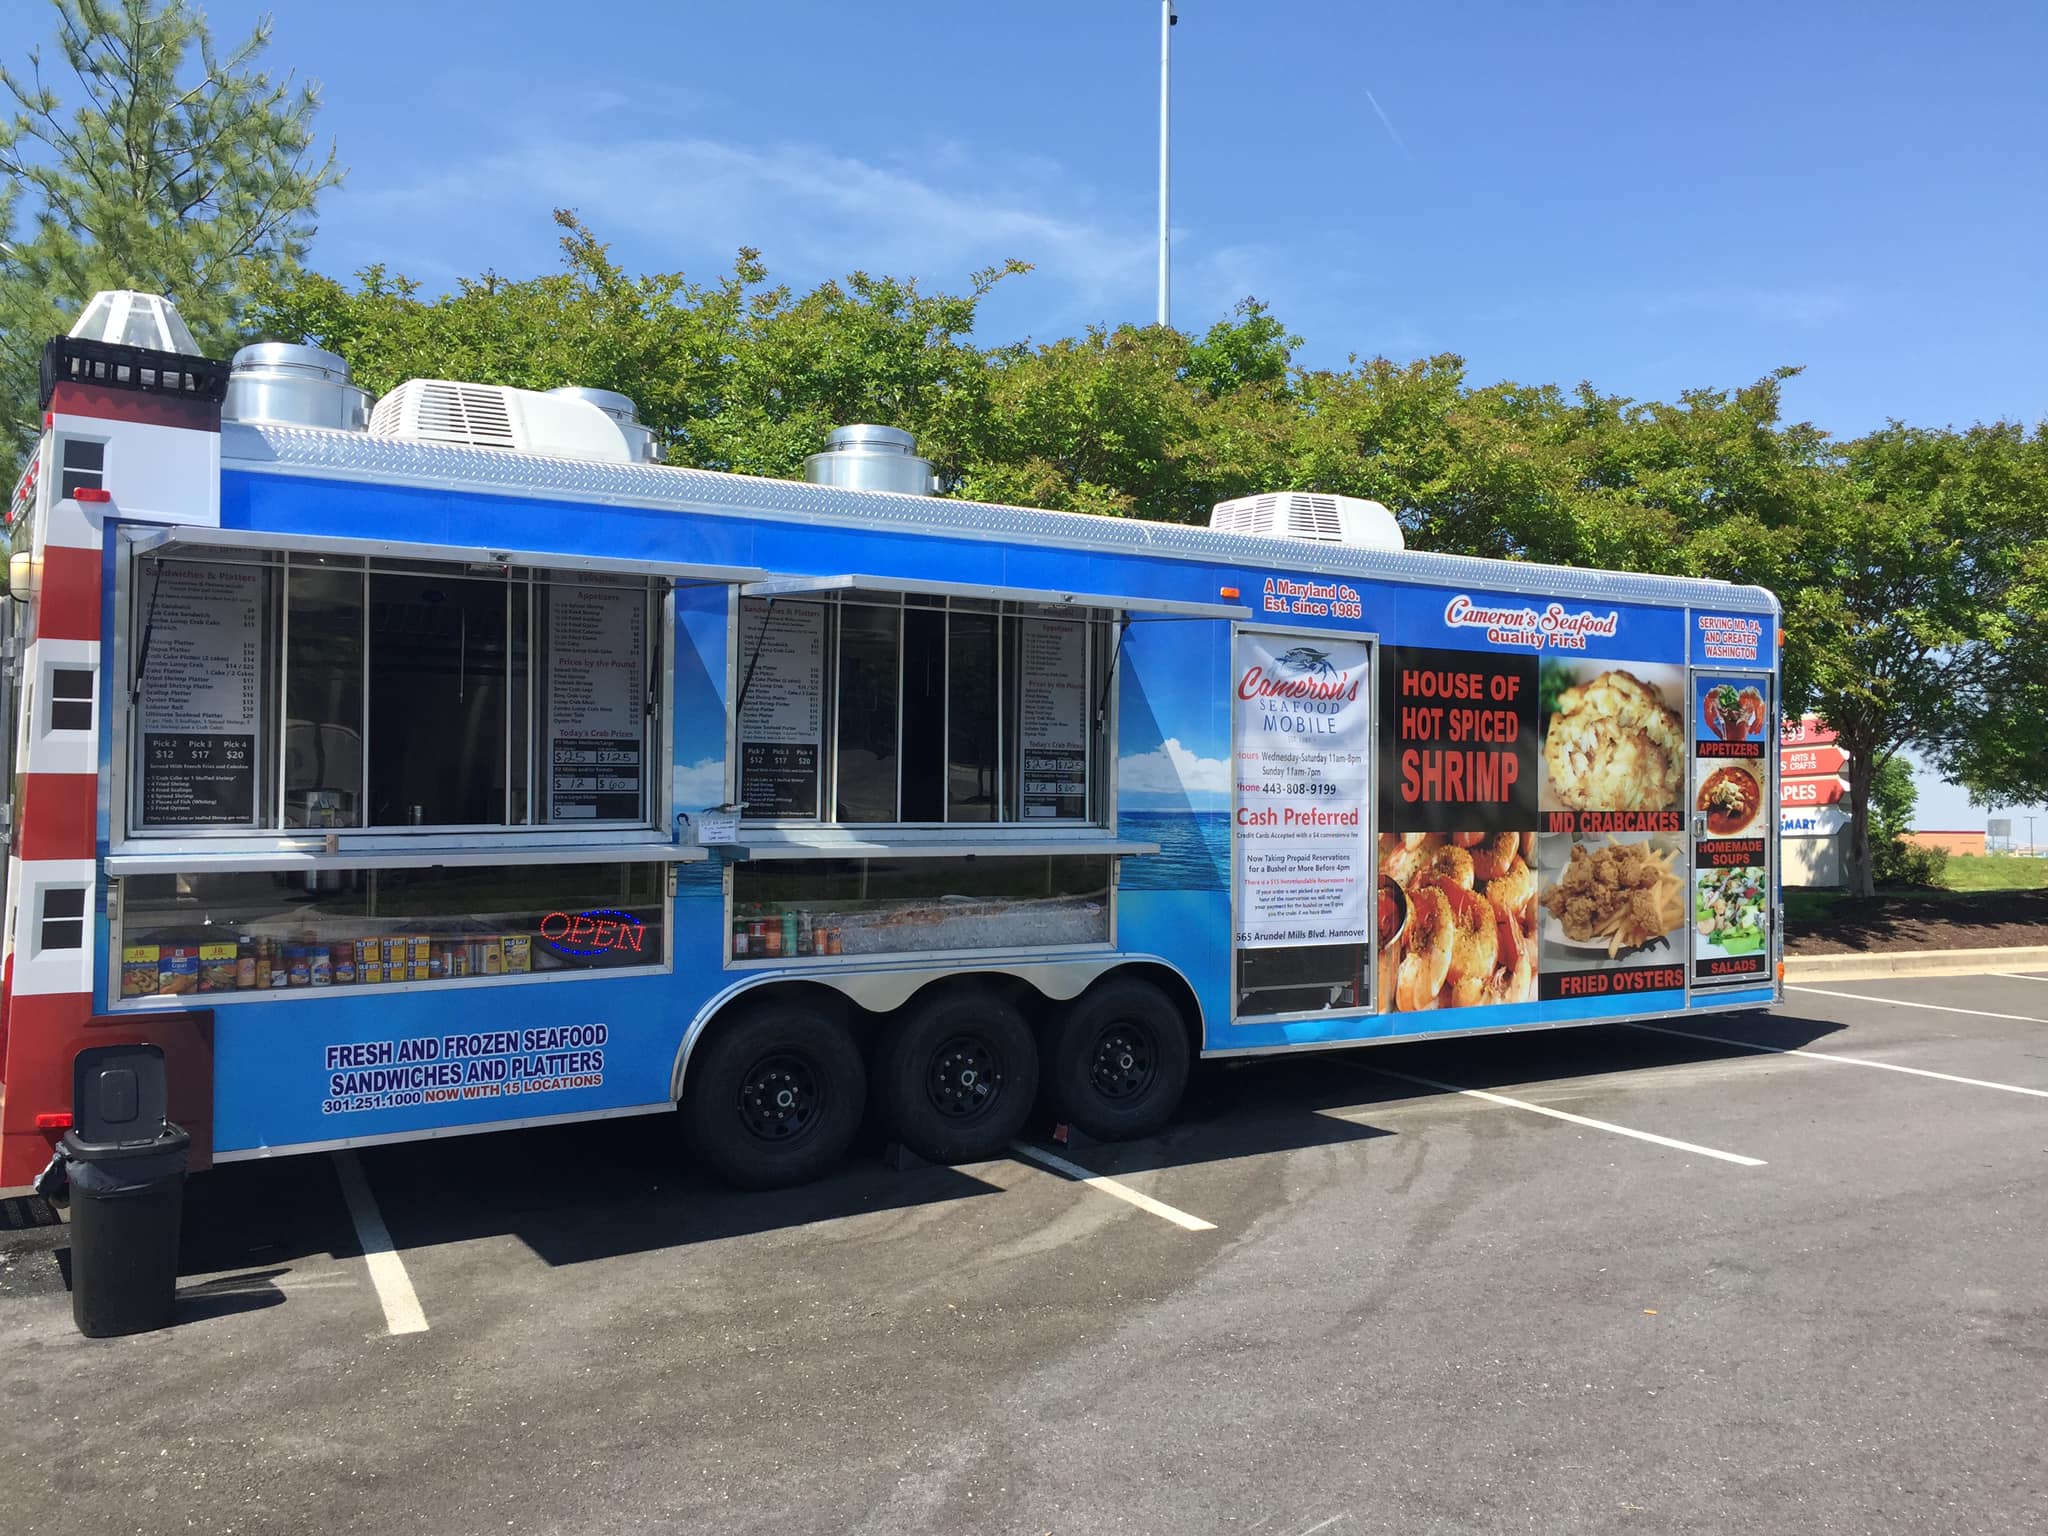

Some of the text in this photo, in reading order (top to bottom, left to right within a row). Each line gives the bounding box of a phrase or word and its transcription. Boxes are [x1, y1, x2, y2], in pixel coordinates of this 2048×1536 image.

[207, 571, 216, 579] &
[1264, 578, 1360, 602] A Maryland Co.
[1264, 598, 1362, 619] Est. since 1985
[1447, 597, 1616, 637] Cameron's Seafood
[1699, 617, 1733, 631] SERVING
[1487, 628, 1586, 649] Quality First
[1705, 632, 1757, 646] AND GREATER
[1705, 646, 1757, 660] WASHINGTON
[1238, 666, 1359, 701] Cameron's
[1402, 669, 1521, 701] HOUSE OF
[1260, 699, 1339, 714] SEAFOOD
[1264, 715, 1337, 734] MOBILE
[1402, 707, 1519, 743] HOT SPICED
[560, 729, 589, 738] Today's
[153, 740, 177, 748] Pick 2
[189, 740, 206, 748] Pick
[1699, 743, 1759, 757] APPETIZERS
[156, 750, 175, 759] $12
[191, 750, 209, 759] $17
[226, 750, 244, 759] $20
[1261, 752, 1327, 765] Wednesday-Saturday
[1790, 752, 1816, 762] ARTS &
[1262, 766, 1321, 778] Sunday 11am-7pm
[1790, 761, 1817, 770] CRAFTS
[1401, 749, 1519, 803] SHRIMP
[1262, 783, 1337, 795] 443-808-9199
[1237, 807, 1359, 826] Cash Preferred
[1549, 811, 1680, 832] MD CRABCAKES
[1271, 832, 1295, 840] Accepted
[1699, 841, 1763, 853] HOMEMADE
[1247, 853, 1351, 863] Now Taking Prepaid Reservations
[1712, 853, 1750, 865] SOUPS
[1266, 865, 1287, 873] Bushel
[1315, 864, 1335, 872] Before
[1336, 864, 1351, 873] 4pm
[540, 911, 646, 951] OPEN
[1254, 931, 1286, 941] Arundel
[1291, 930, 1306, 940] Mills
[1308, 929, 1327, 938] Blvd.
[1329, 929, 1365, 937] Hannover
[1711, 960, 1757, 974] SALADS
[1560, 969, 1684, 995] FRIED OYSTERS
[327, 1024, 608, 1068] FRESH AND FROZEN SEAFOOD
[331, 1051, 604, 1096] SANDWICHES AND PLATTERS
[323, 1074, 603, 1114] 301.251.1000 NOW WITH 15 LOCATIONS
